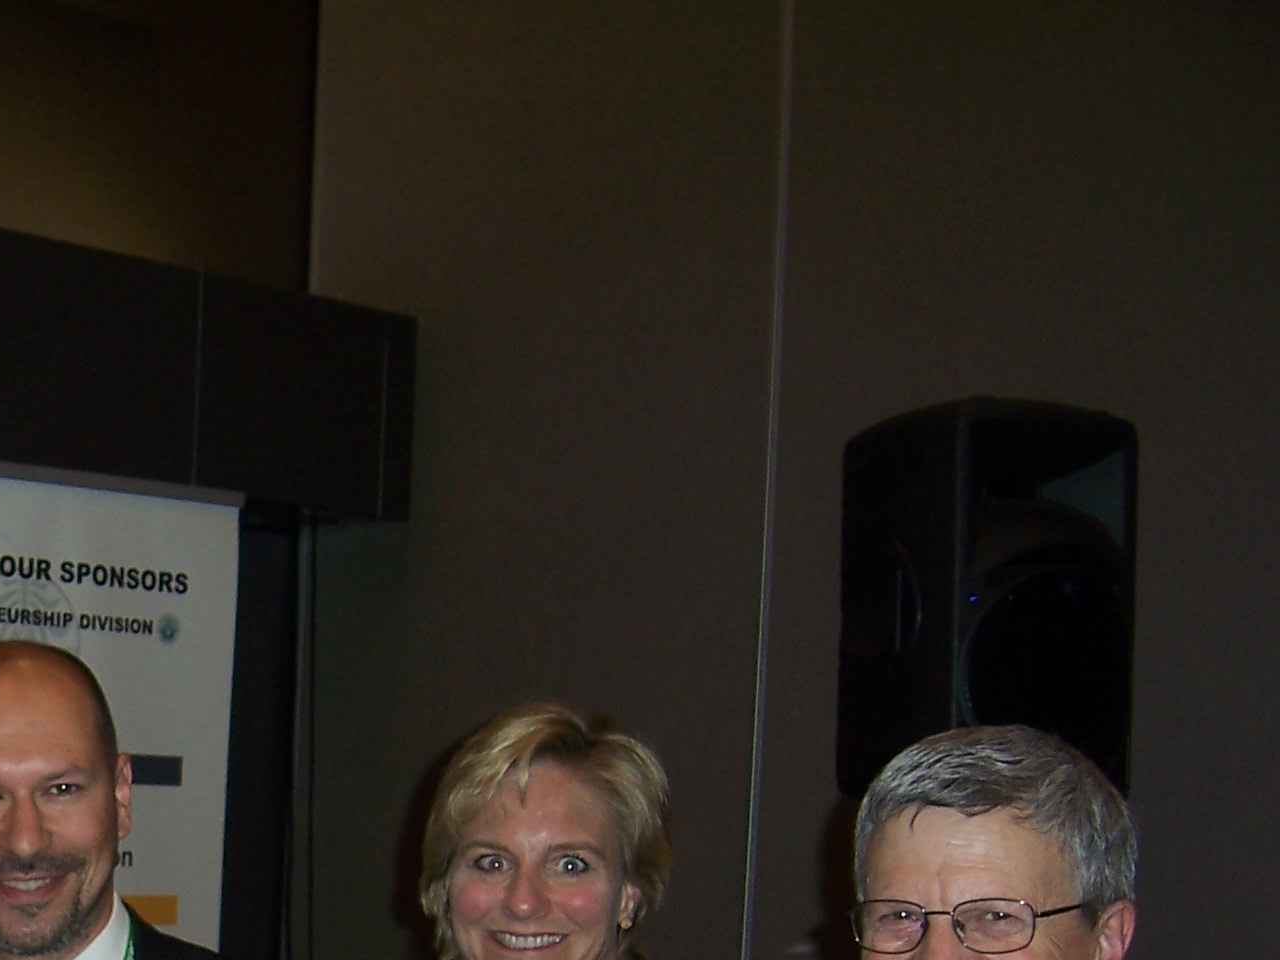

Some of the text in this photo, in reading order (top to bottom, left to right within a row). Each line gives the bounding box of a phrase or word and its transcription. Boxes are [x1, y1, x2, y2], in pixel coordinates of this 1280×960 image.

[0, 554, 51, 582] OUR
[60, 561, 189, 594] SPONSORS
[79, 613, 154, 635] DIVISION
